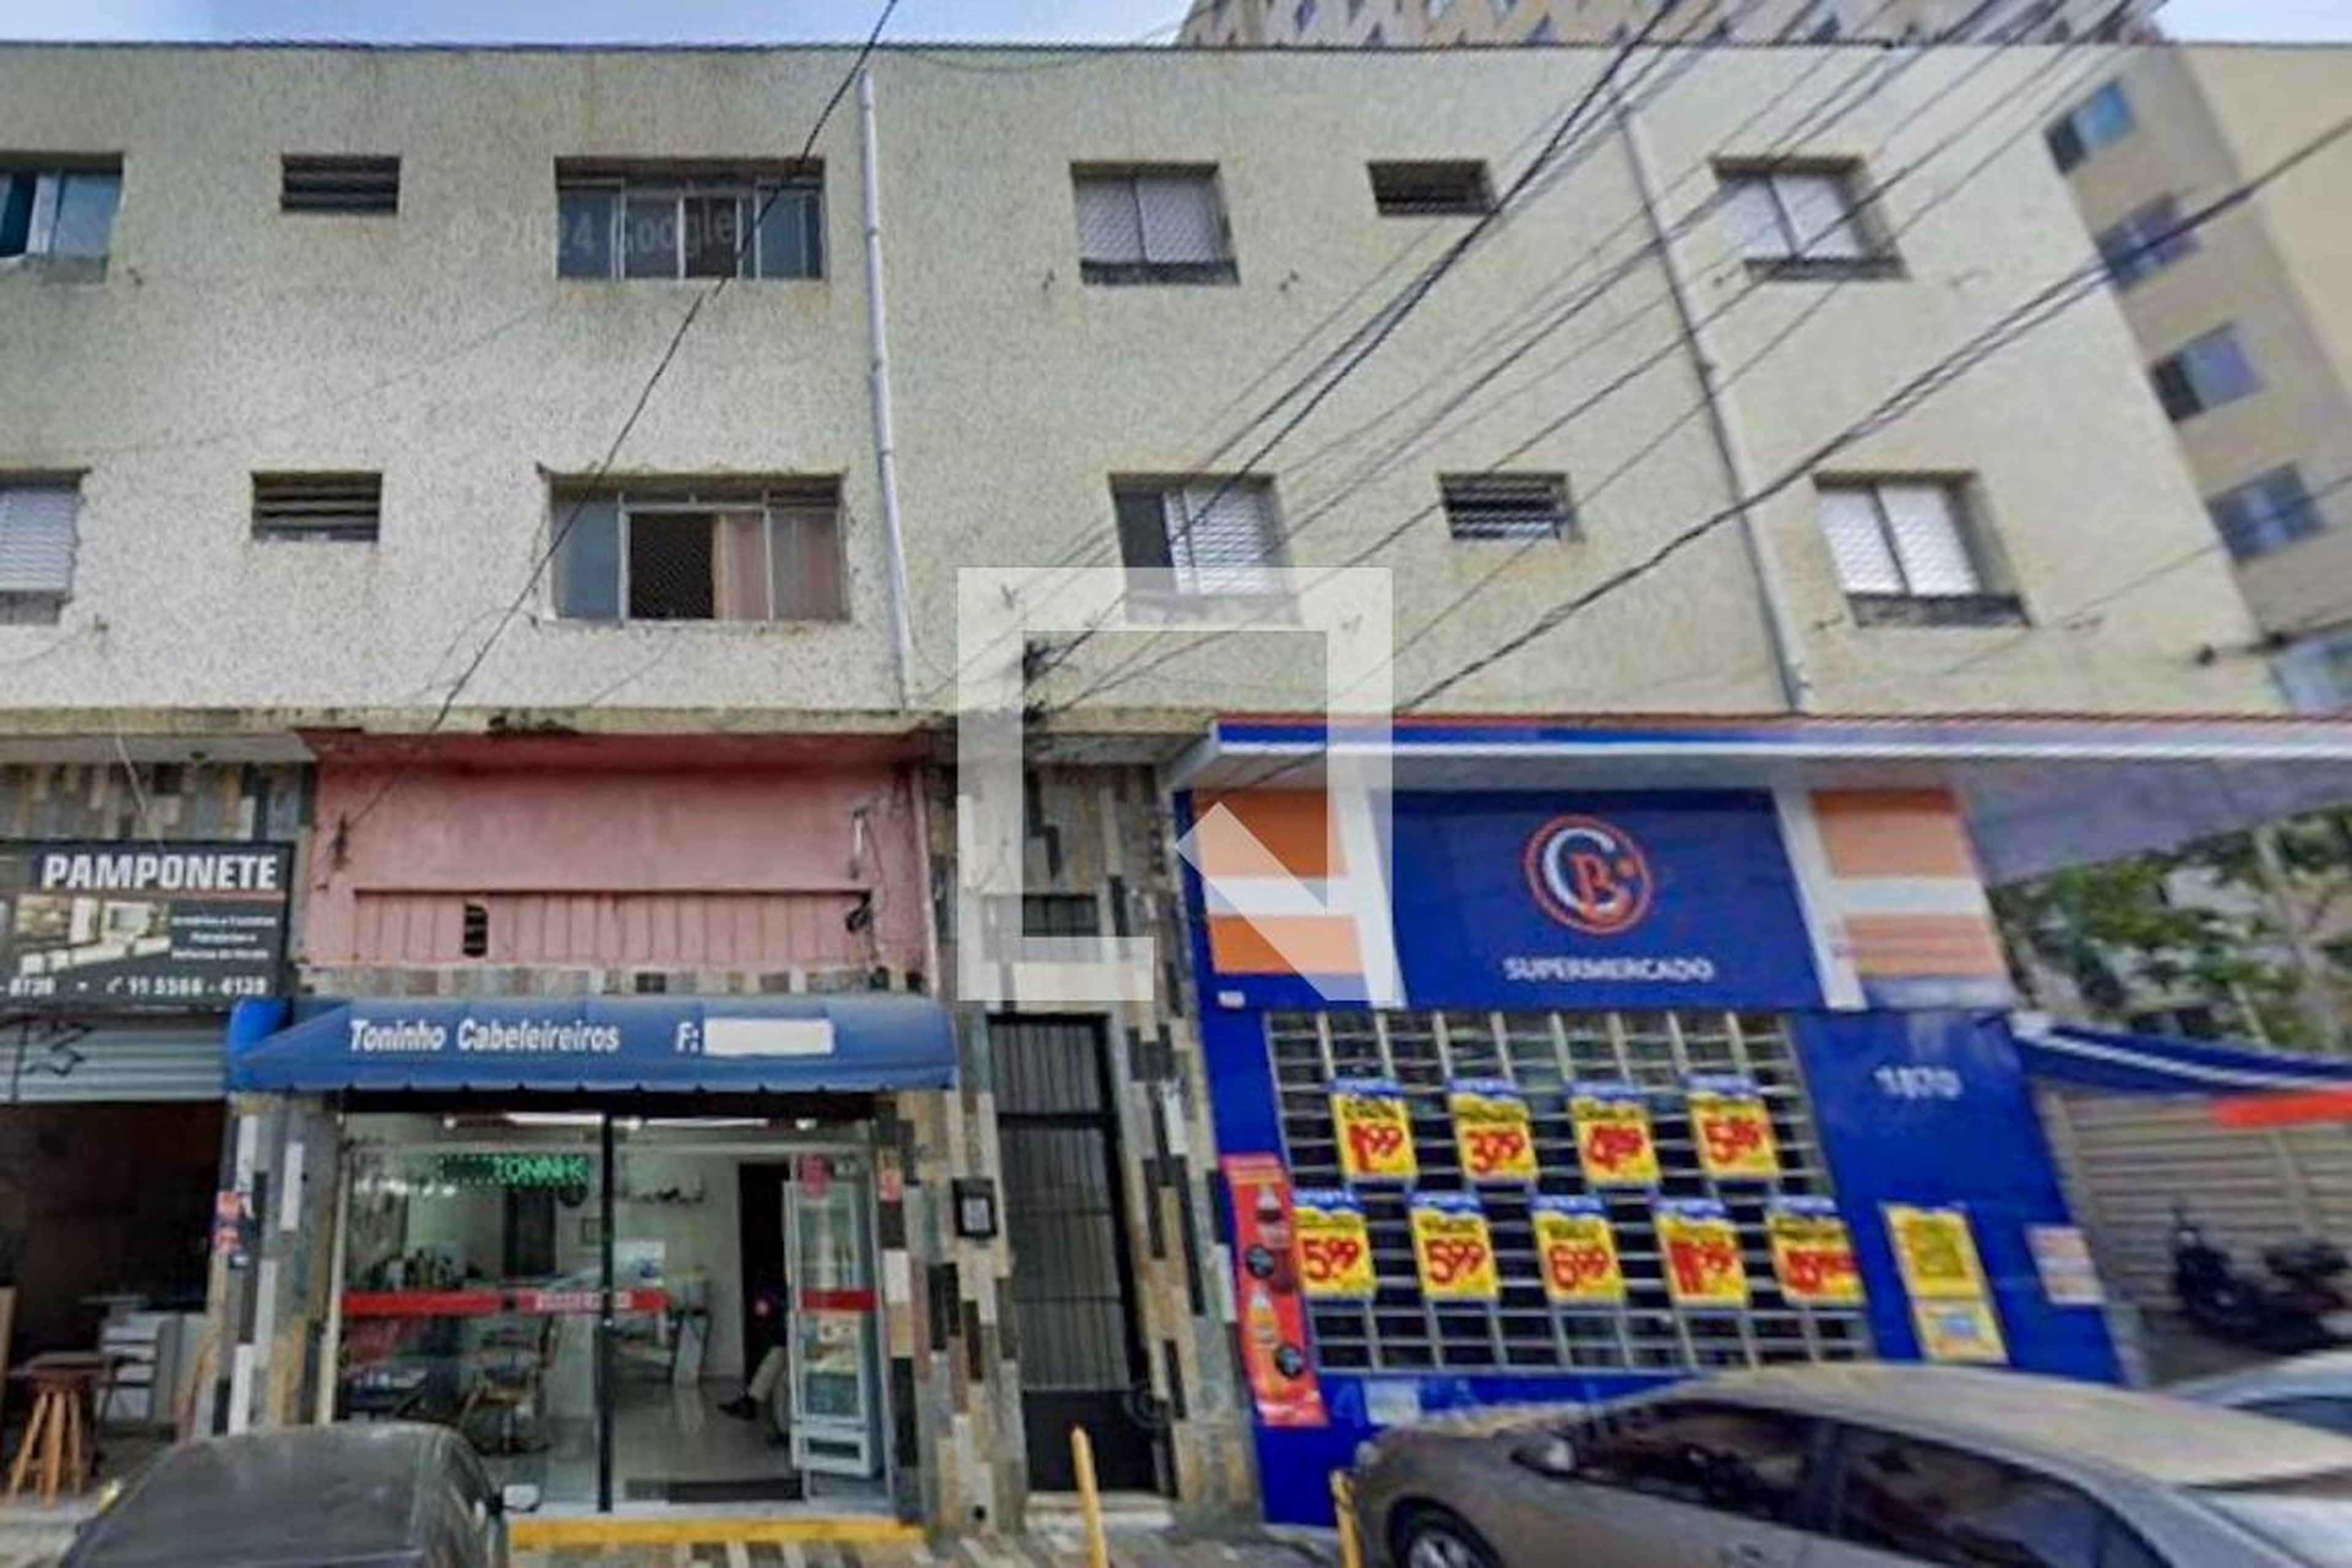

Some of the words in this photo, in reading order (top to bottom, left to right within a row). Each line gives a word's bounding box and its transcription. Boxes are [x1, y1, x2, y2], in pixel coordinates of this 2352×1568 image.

[41, 854, 277, 890] PAMPONETE
[1502, 956, 1715, 981] SUPERMERCADO
[350, 1019, 447, 1051] Toninho
[457, 1017, 620, 1051] Cabeleireiros
[676, 1022, 699, 1052] F:
